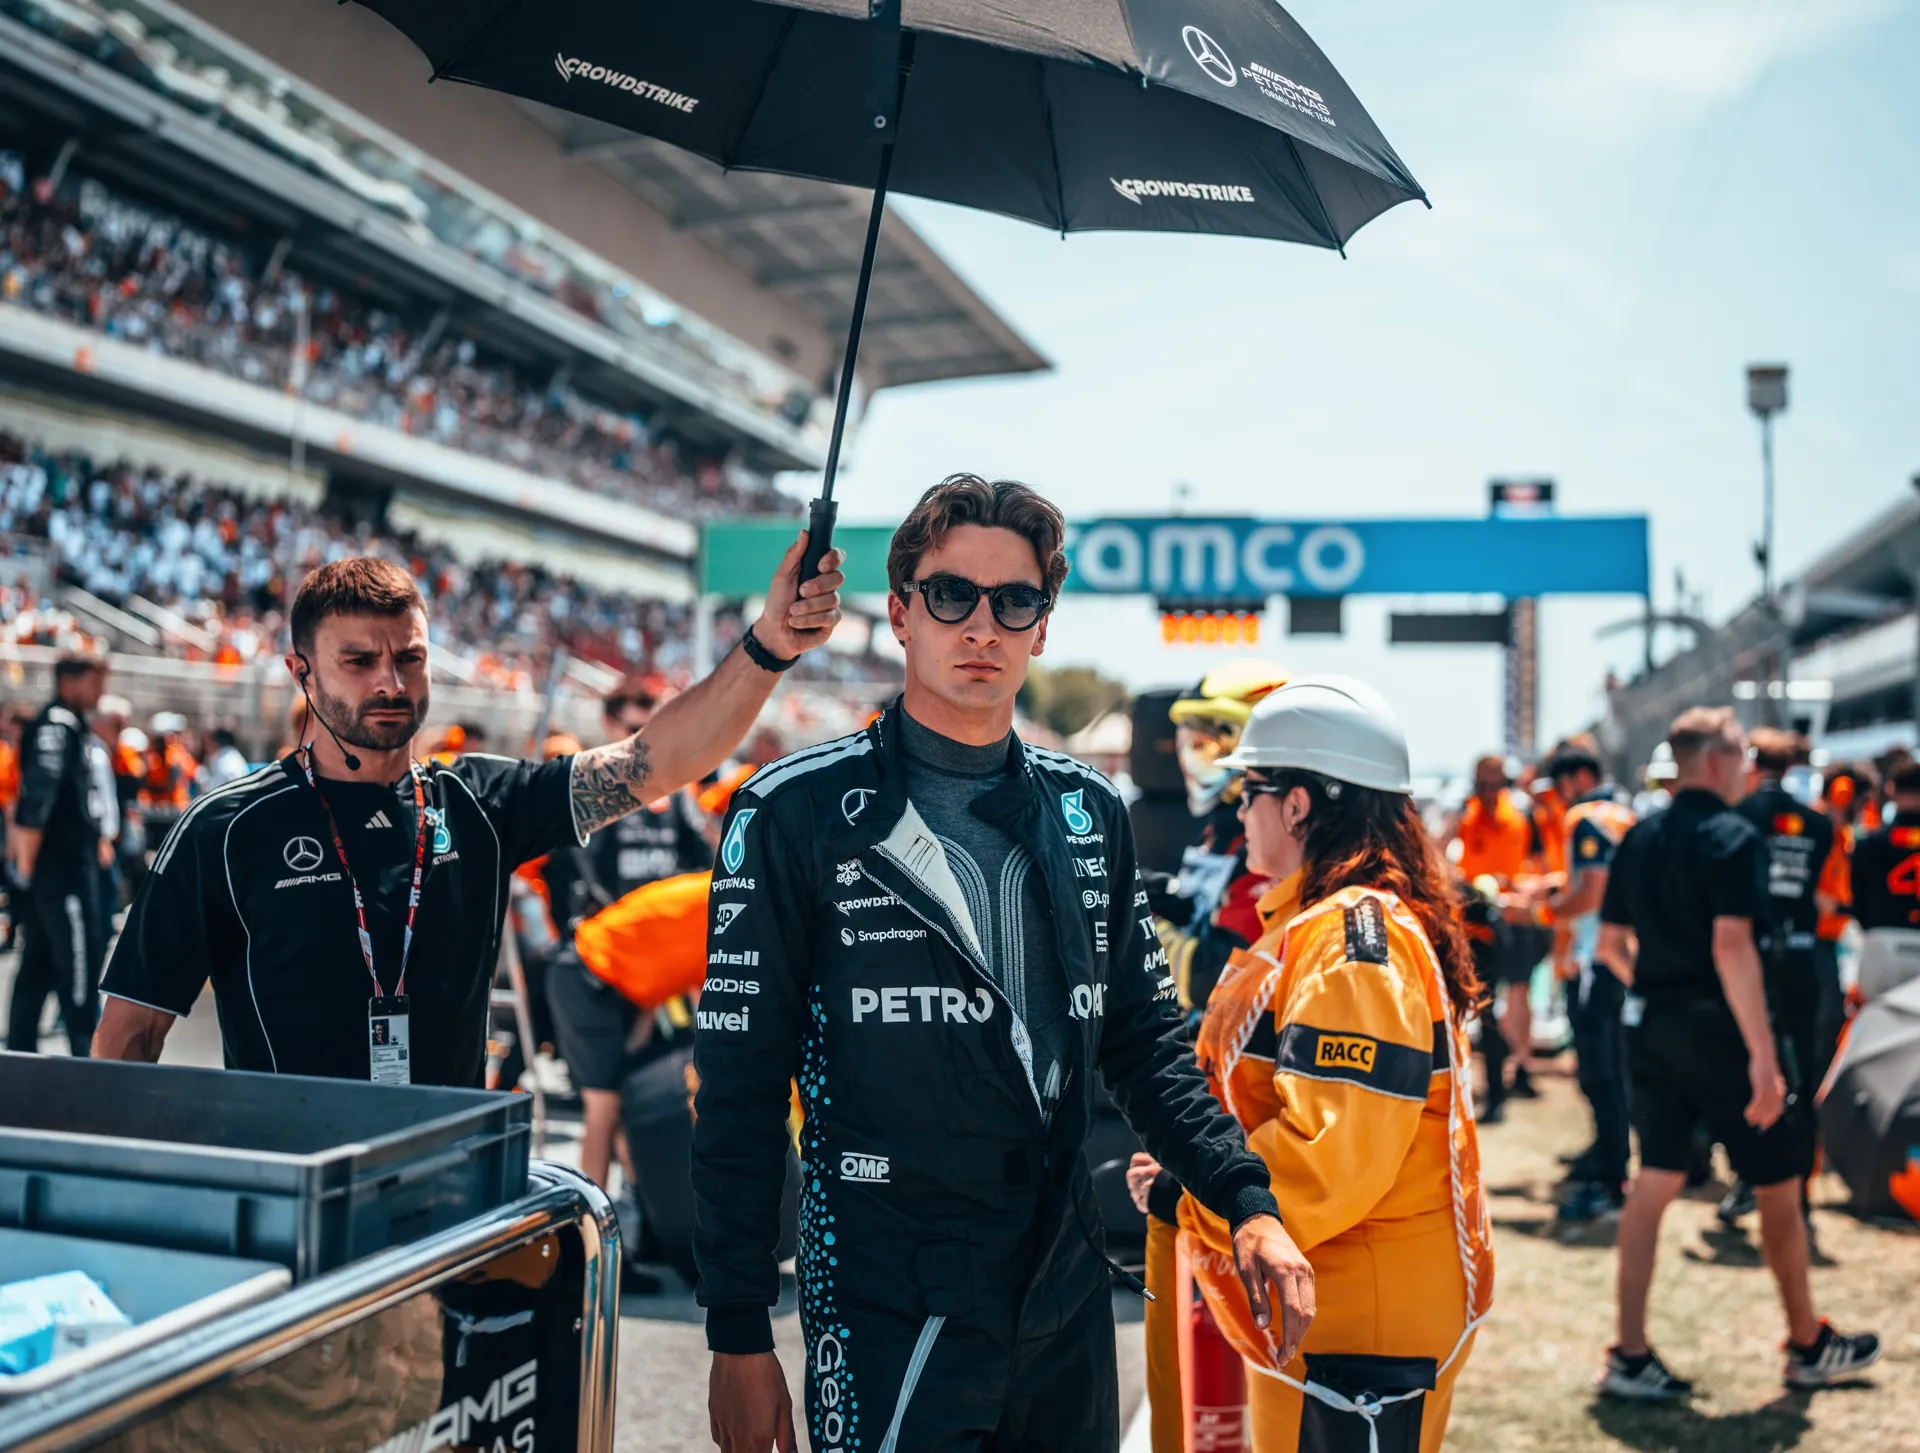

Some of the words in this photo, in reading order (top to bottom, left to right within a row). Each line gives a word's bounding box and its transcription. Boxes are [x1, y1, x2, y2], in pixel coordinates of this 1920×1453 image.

[564, 57, 699, 113] CROWDSTRIKE
[1240, 66, 1331, 116] PETRONAS
[1260, 86, 1298, 110] FORMULA
[1297, 104, 1315, 118] ONE
[1313, 111, 1337, 127] TEAM
[1121, 179, 1255, 203] CROWDSTRIKE
[712, 877, 756, 892] PETRONAS
[857, 928, 927, 943] Snapdragon
[696, 1006, 750, 1032] nuvei
[1320, 1041, 1372, 1066] RACC
[840, 1156, 890, 1179] OMP
[420, 1358, 538, 1453] AMG
[817, 1332, 845, 1453] Geo
